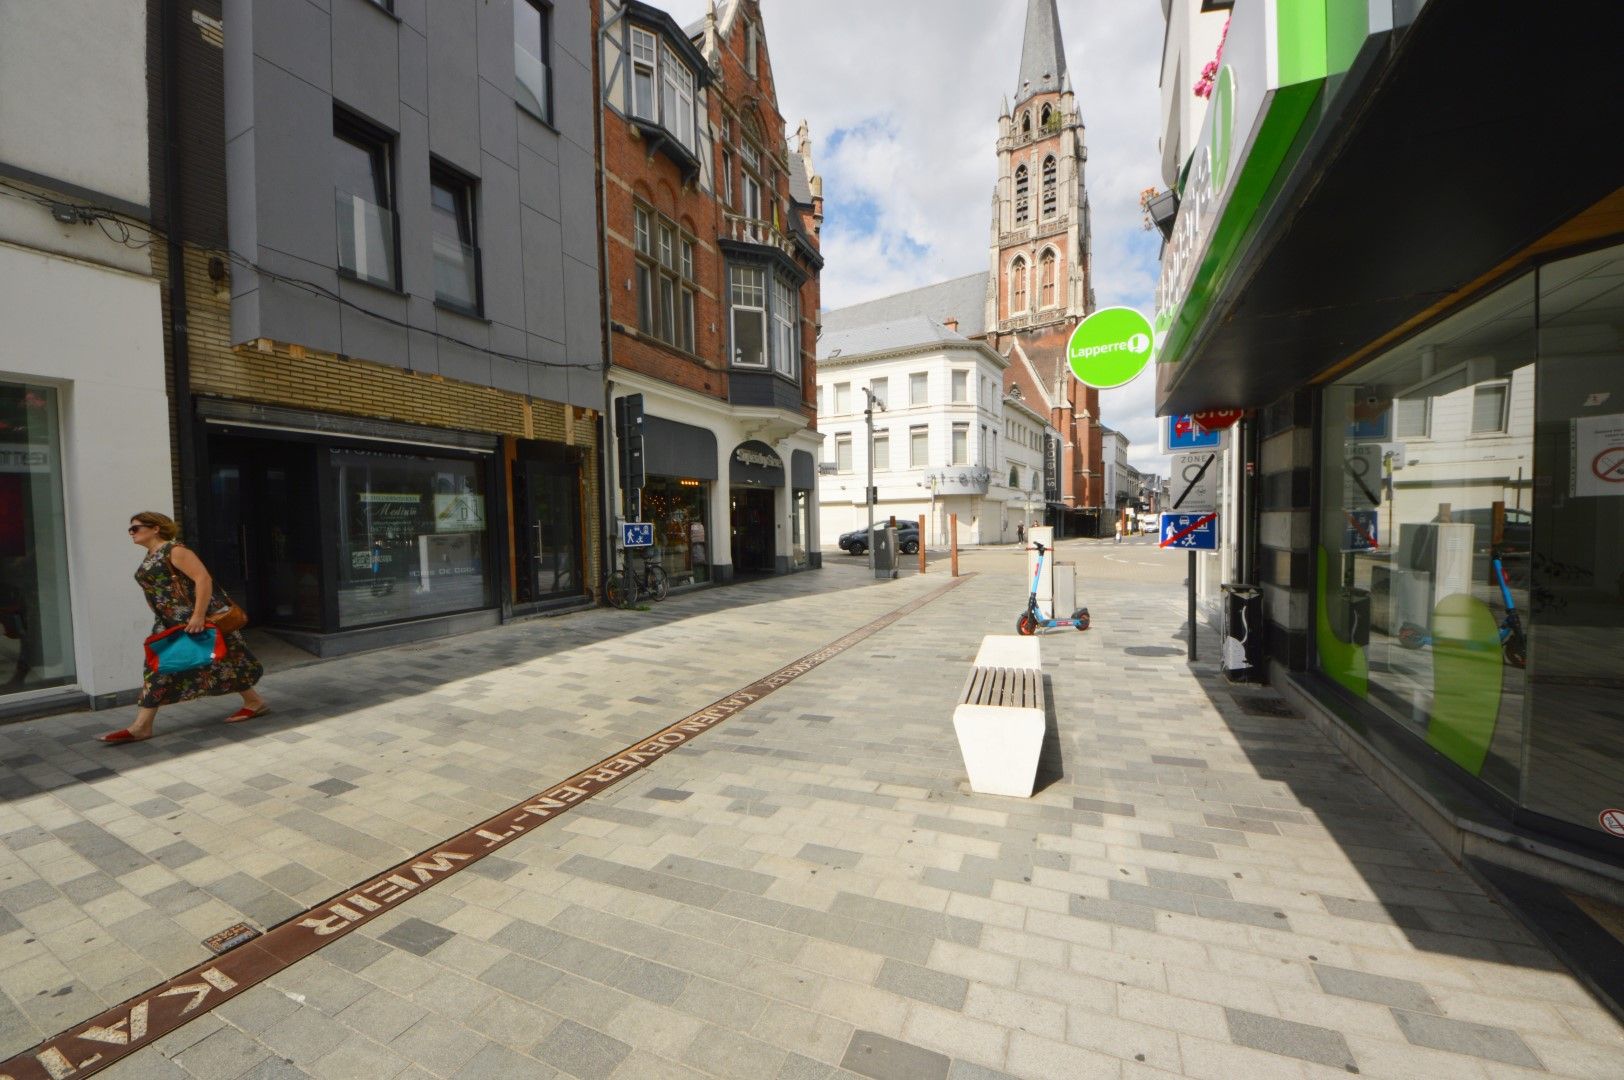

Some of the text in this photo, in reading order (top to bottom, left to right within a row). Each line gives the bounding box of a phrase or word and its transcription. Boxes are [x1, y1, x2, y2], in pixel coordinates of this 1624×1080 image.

[1071, 341, 1127, 359] Lapperre
[1181, 455, 1206, 463] ZONE
[297, 851, 473, 936] WEIR
